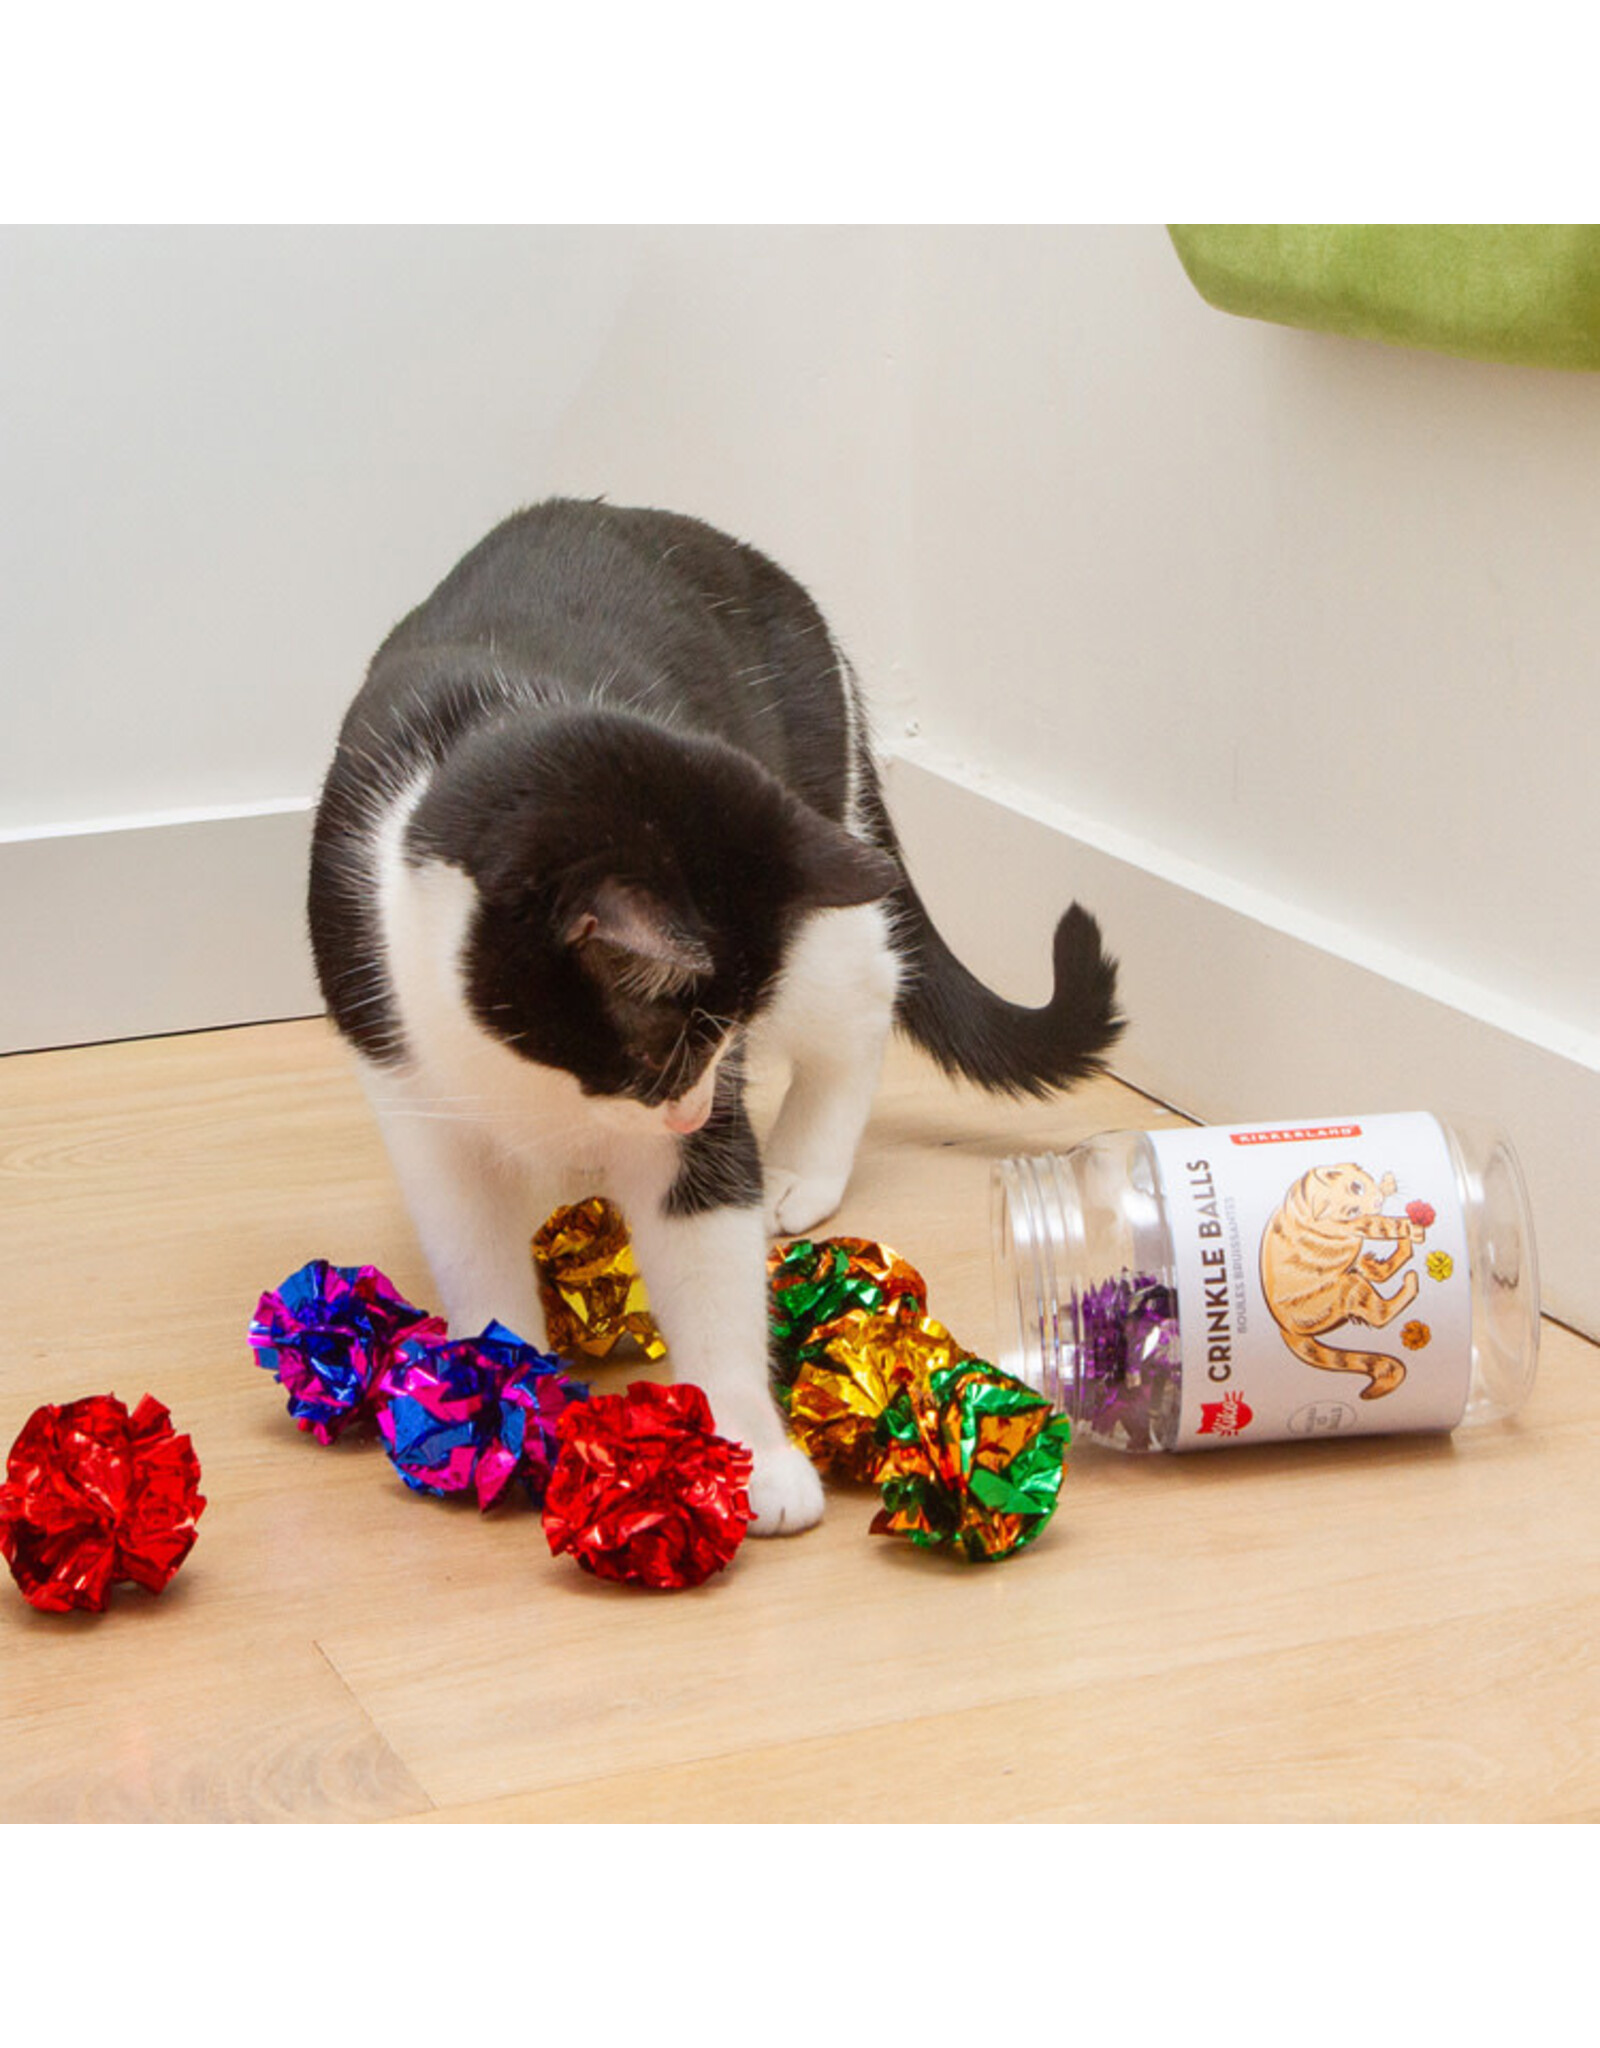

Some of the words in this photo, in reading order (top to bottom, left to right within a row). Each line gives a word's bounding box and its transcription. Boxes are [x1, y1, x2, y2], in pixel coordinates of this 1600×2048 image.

[1186, 1159, 1222, 1239] BALLS
[1202, 1248, 1231, 1382] CRINKLE
[1234, 1281, 1247, 1334] BOULES
